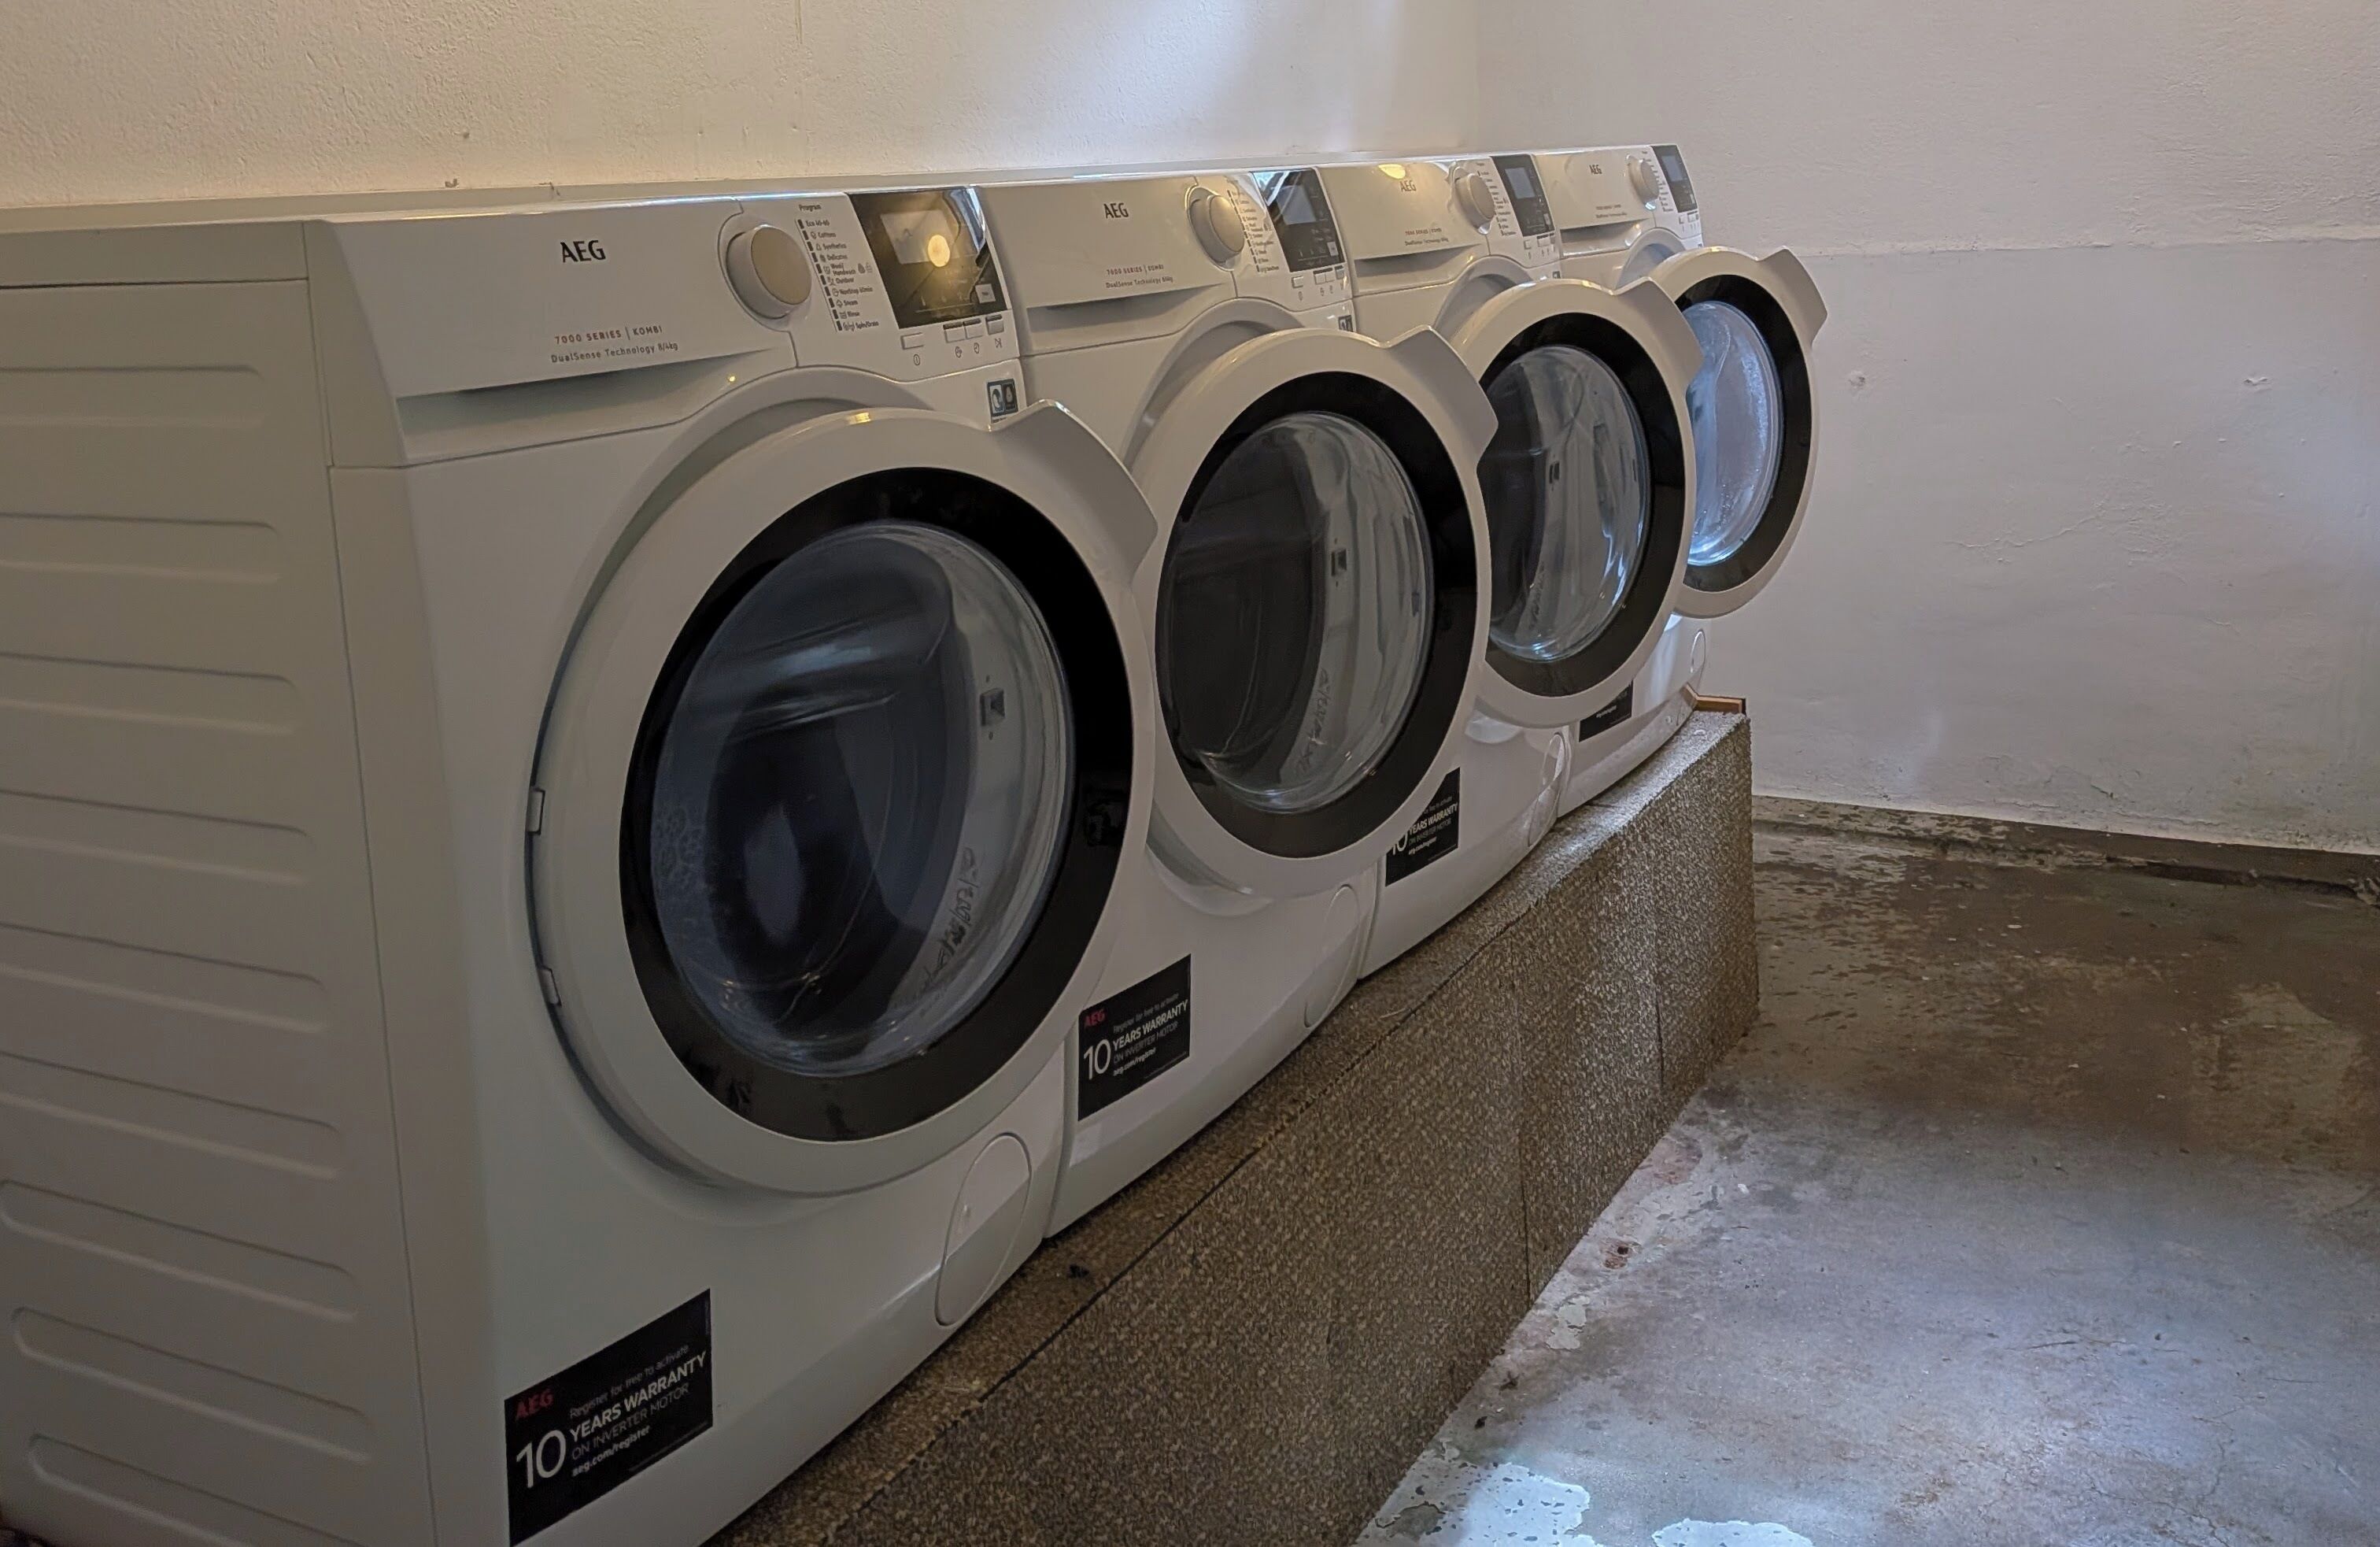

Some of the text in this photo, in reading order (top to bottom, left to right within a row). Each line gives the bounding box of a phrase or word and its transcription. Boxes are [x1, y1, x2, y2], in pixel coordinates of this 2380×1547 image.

[1400, 180, 1417, 192] AEG
[1103, 202, 1129, 219] AEG
[560, 240, 606, 263] AEG
[554, 325, 663, 345] 7000 SERIES KOMBI
[551, 351, 601, 364] DualSense
[604, 344, 655, 358] Technology
[1112, 999, 1188, 1052] YEARS WARRANTY
[1084, 1038, 1111, 1080] 10
[516, 1389, 553, 1421] AEG
[570, 1350, 707, 1442] YEARS WARRANTY
[572, 1445, 592, 1460] ON
[593, 1409, 647, 1449] INVERTER
[650, 1382, 689, 1414] MOTOR
[516, 1429, 566, 1489] 10
[572, 1425, 651, 1477] aeg.com/register
